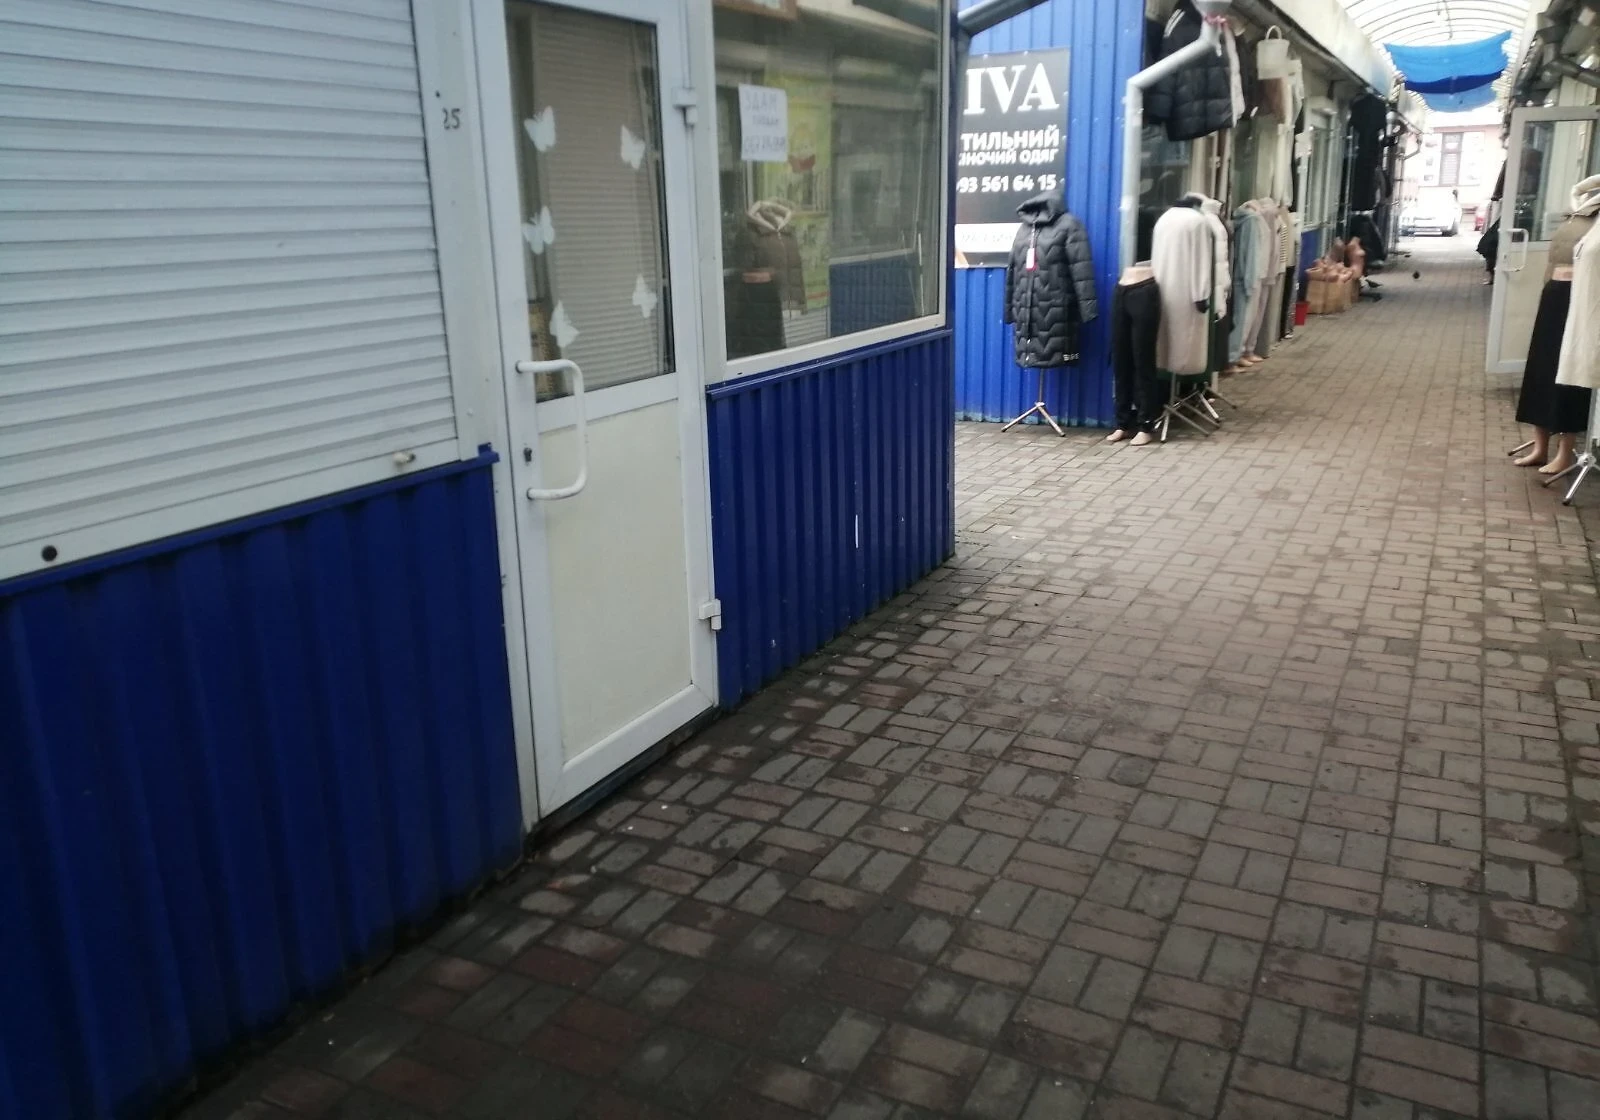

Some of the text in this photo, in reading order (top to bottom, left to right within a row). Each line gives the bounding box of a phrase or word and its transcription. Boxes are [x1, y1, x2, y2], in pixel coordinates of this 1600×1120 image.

[963, 63, 1060, 115] IVA
[442, 107, 460, 130] 25
[960, 124, 1060, 151] ТИЛЬНИЙ
[958, 148, 1017, 166] ІНОЧИЙ
[956, 174, 1056, 193] 93 561 64 15
